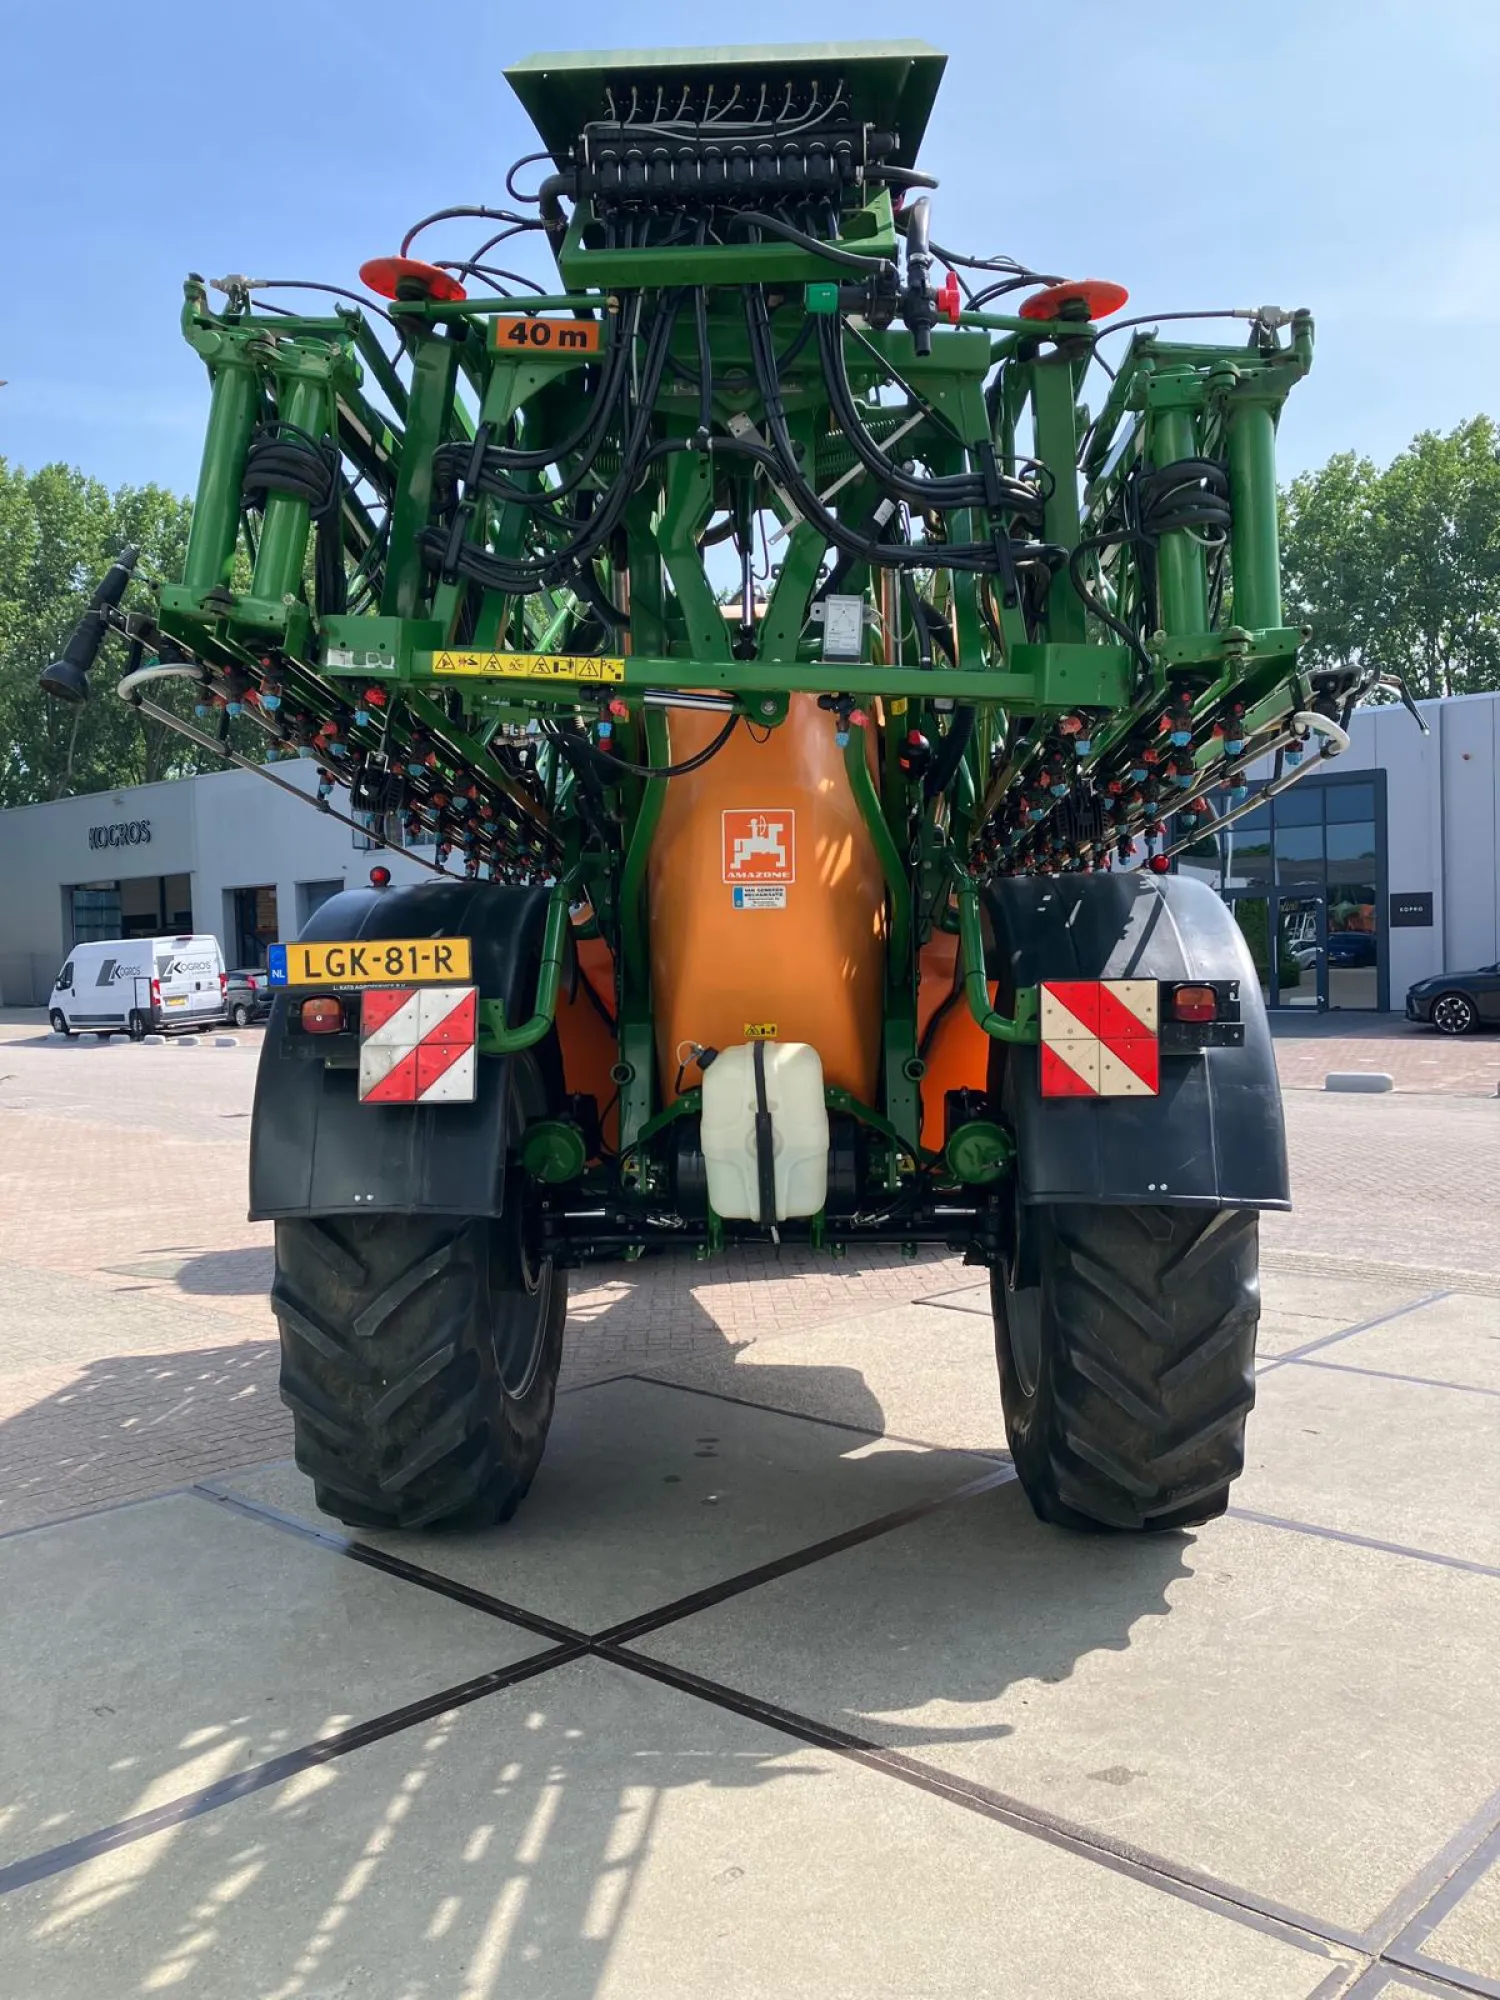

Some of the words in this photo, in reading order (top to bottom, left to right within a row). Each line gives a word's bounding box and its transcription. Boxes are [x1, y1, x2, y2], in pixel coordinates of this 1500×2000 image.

[508, 322, 551, 346] 40
[558, 329, 587, 348] m
[89, 820, 151, 850] KOGROS
[727, 871, 791, 879] AMAZONE
[304, 944, 454, 978] LGK-81-R
[271, 970, 286, 979] NL
